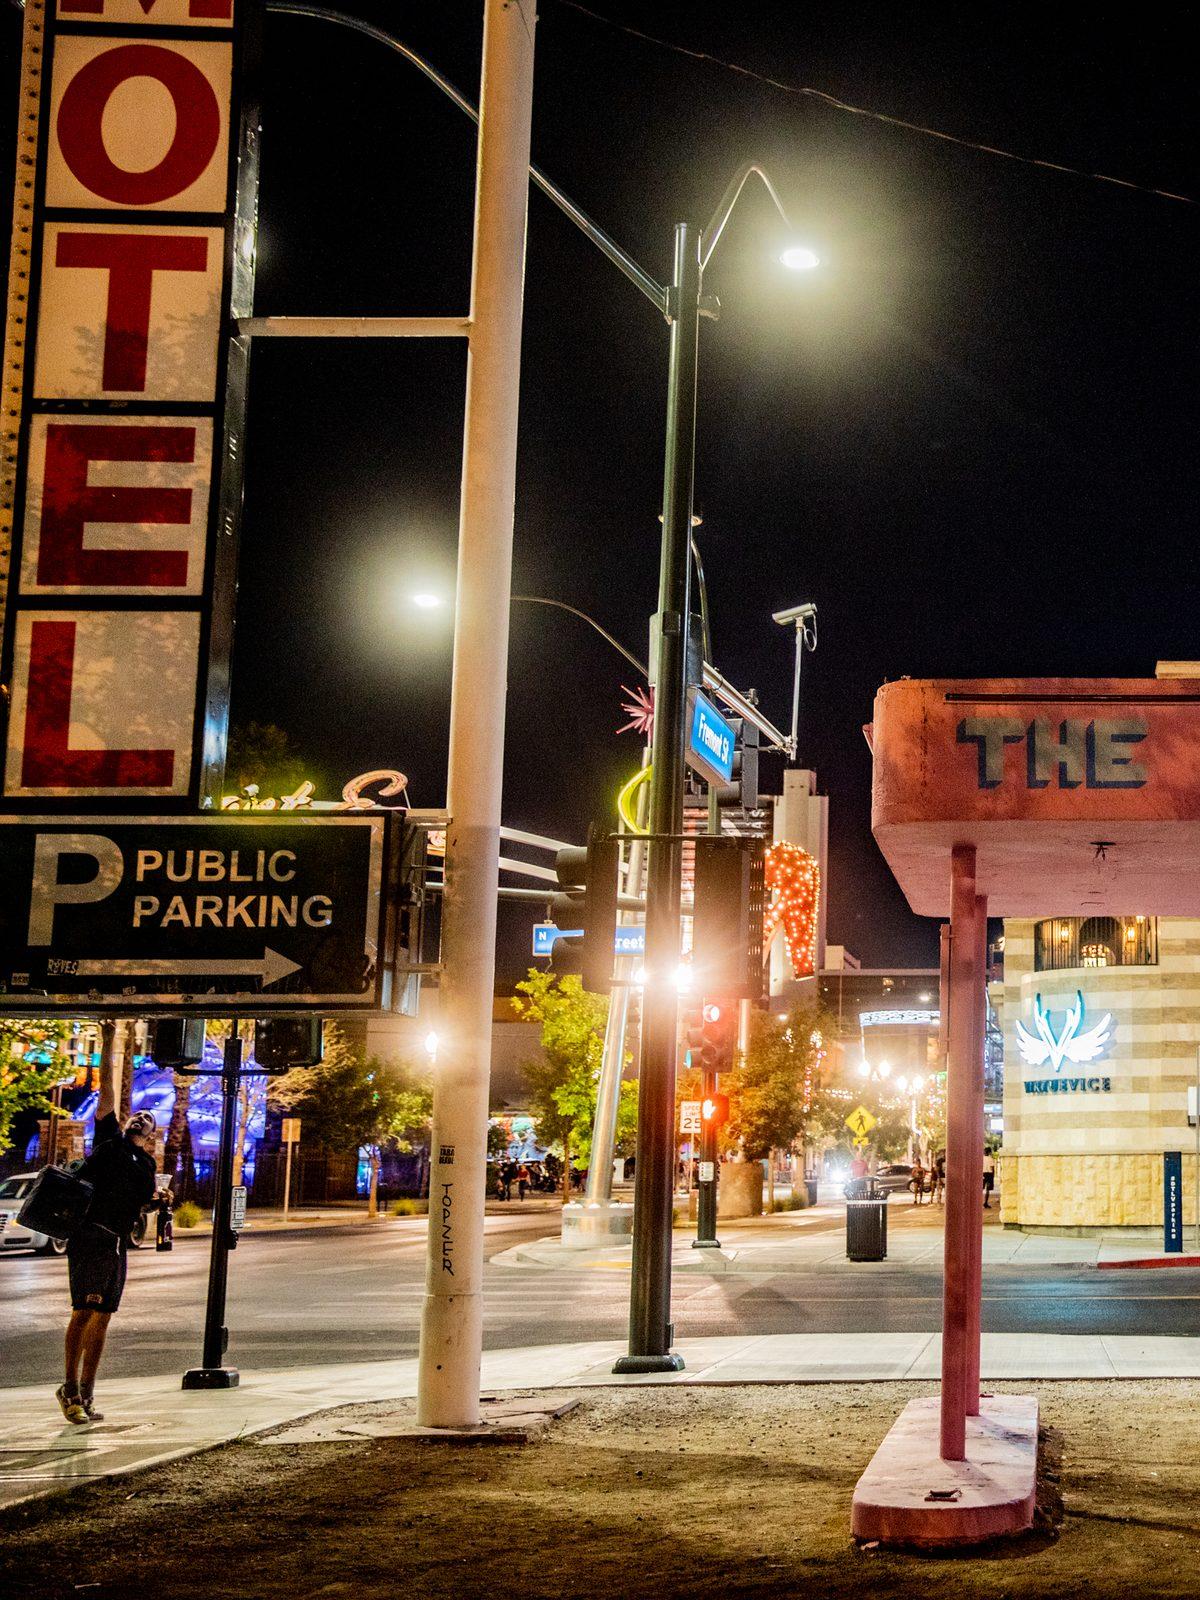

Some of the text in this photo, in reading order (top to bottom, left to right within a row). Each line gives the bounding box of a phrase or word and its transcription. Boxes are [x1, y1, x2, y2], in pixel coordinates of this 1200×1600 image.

[21, 0, 233, 788] OTEL
[698, 712, 730, 765] Fremont St
[956, 717, 1149, 789] THE
[136, 849, 297, 882] PUBLIC
[27, 833, 125, 946] P
[132, 895, 334, 928] PARKING
[615, 935, 645, 950] reet
[684, 1118, 701, 1128] 25
